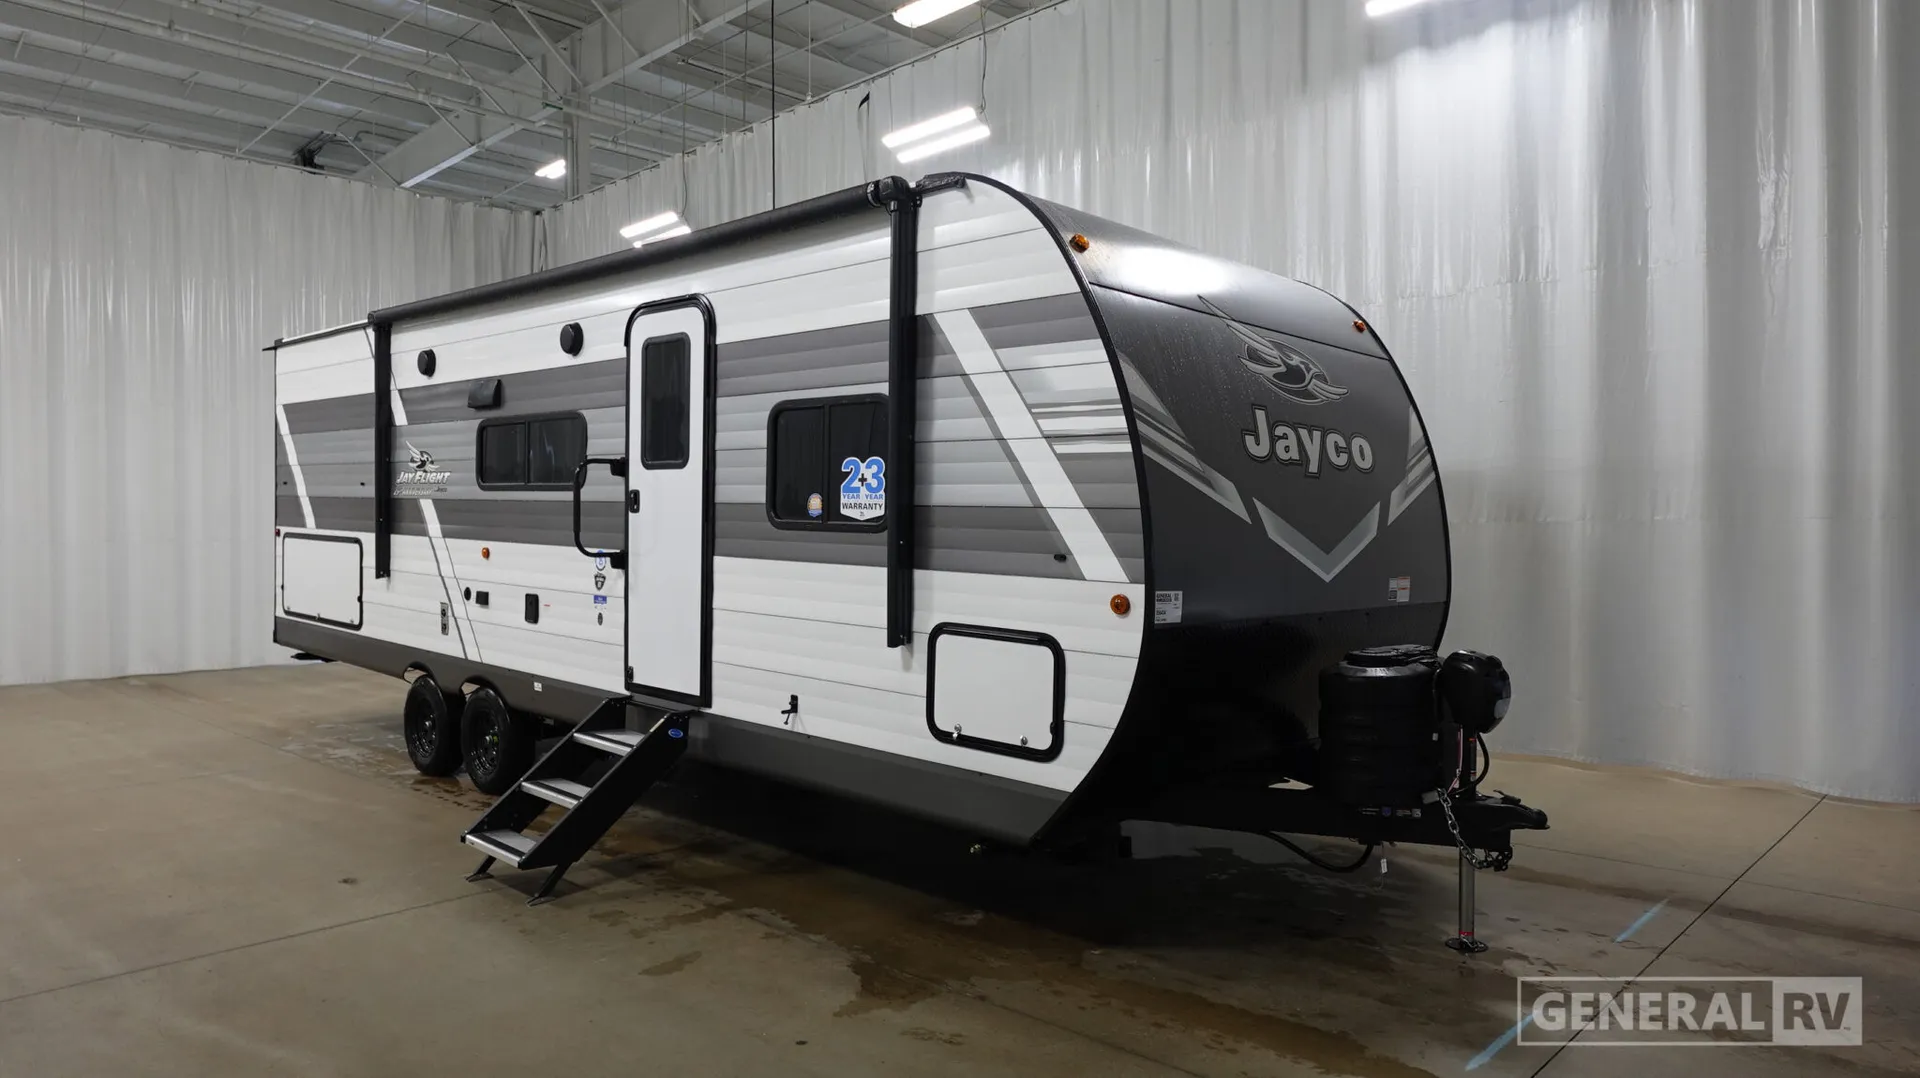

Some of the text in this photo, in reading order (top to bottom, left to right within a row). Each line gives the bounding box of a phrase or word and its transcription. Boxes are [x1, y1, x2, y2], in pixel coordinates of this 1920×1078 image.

[1242, 405, 1374, 477] Jayco
[396, 470, 451, 484] JAY FLIGHT
